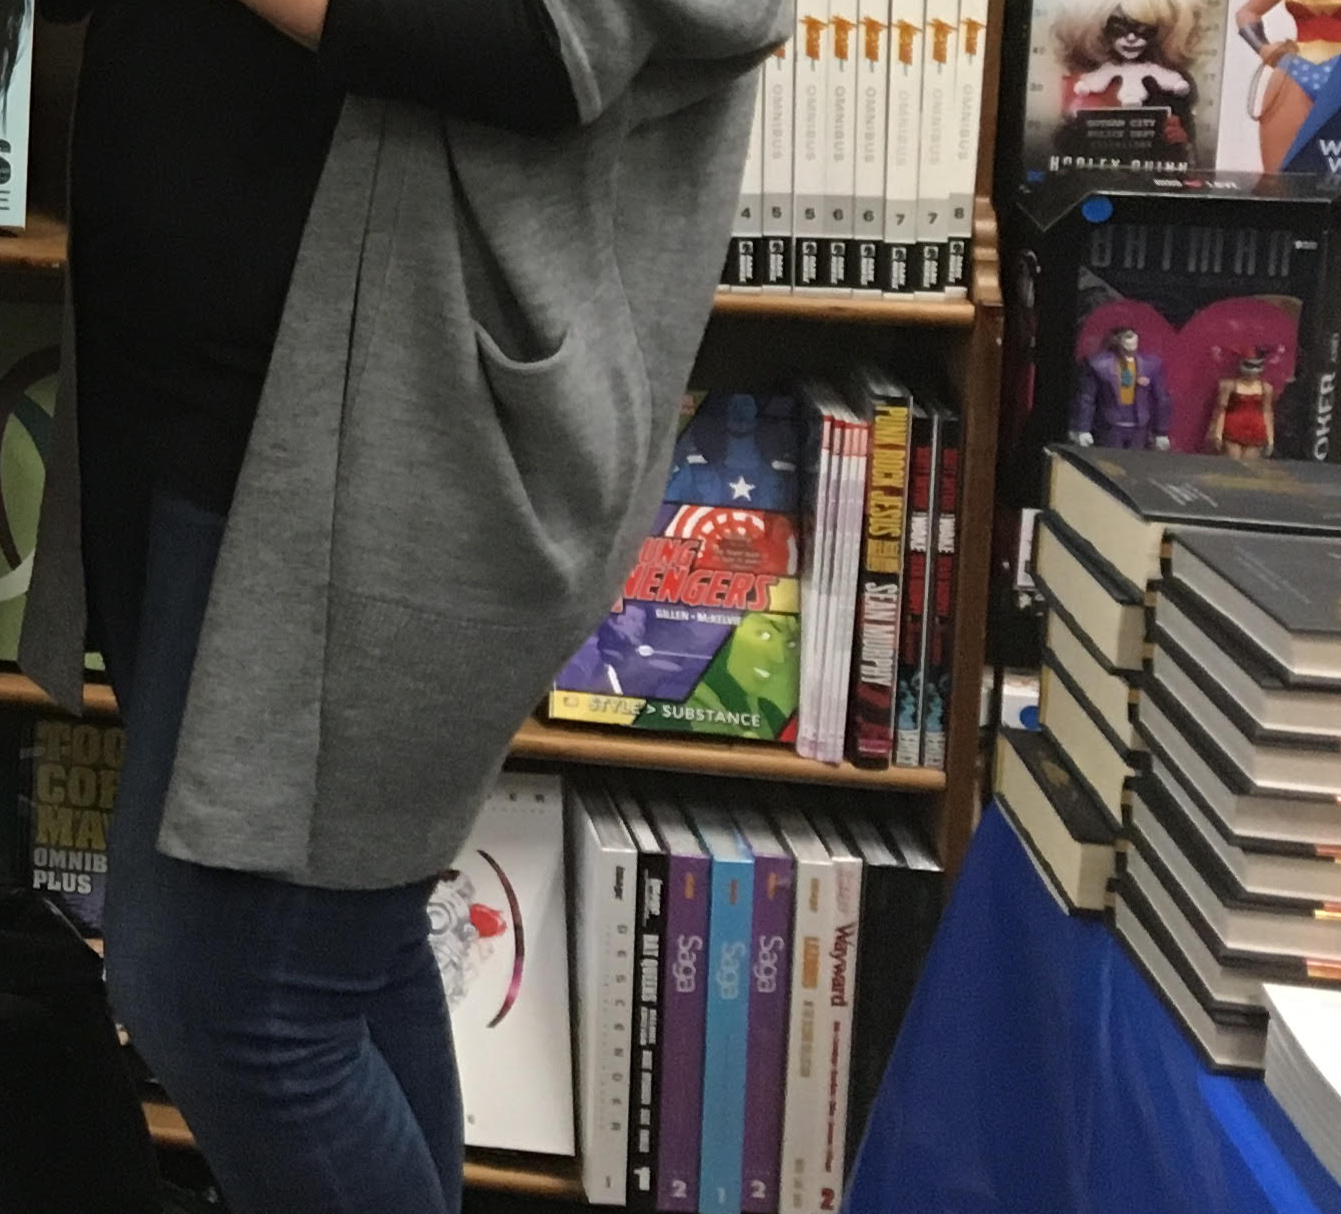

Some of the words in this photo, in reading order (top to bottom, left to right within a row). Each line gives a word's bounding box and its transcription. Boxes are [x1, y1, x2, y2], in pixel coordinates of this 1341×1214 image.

[833, 85, 847, 163] OMNIBUS
[864, 86, 877, 164] OMNIBUS
[1130, 119, 1156, 127] CITY
[874, 406, 908, 448] PUNK
[868, 490, 904, 537] JESUS
[656, 609, 689, 621] GILLEN
[862, 581, 898, 620] SEAN
[860, 622, 897, 686] MURPHY
[662, 704, 761, 727] SUBSTANCE
[33, 869, 92, 894] PLUS
[672, 934, 703, 994] Saga
[717, 941, 746, 1000] Saga
[753, 935, 785, 994] Saga
[829, 920, 857, 1008] Wayward
